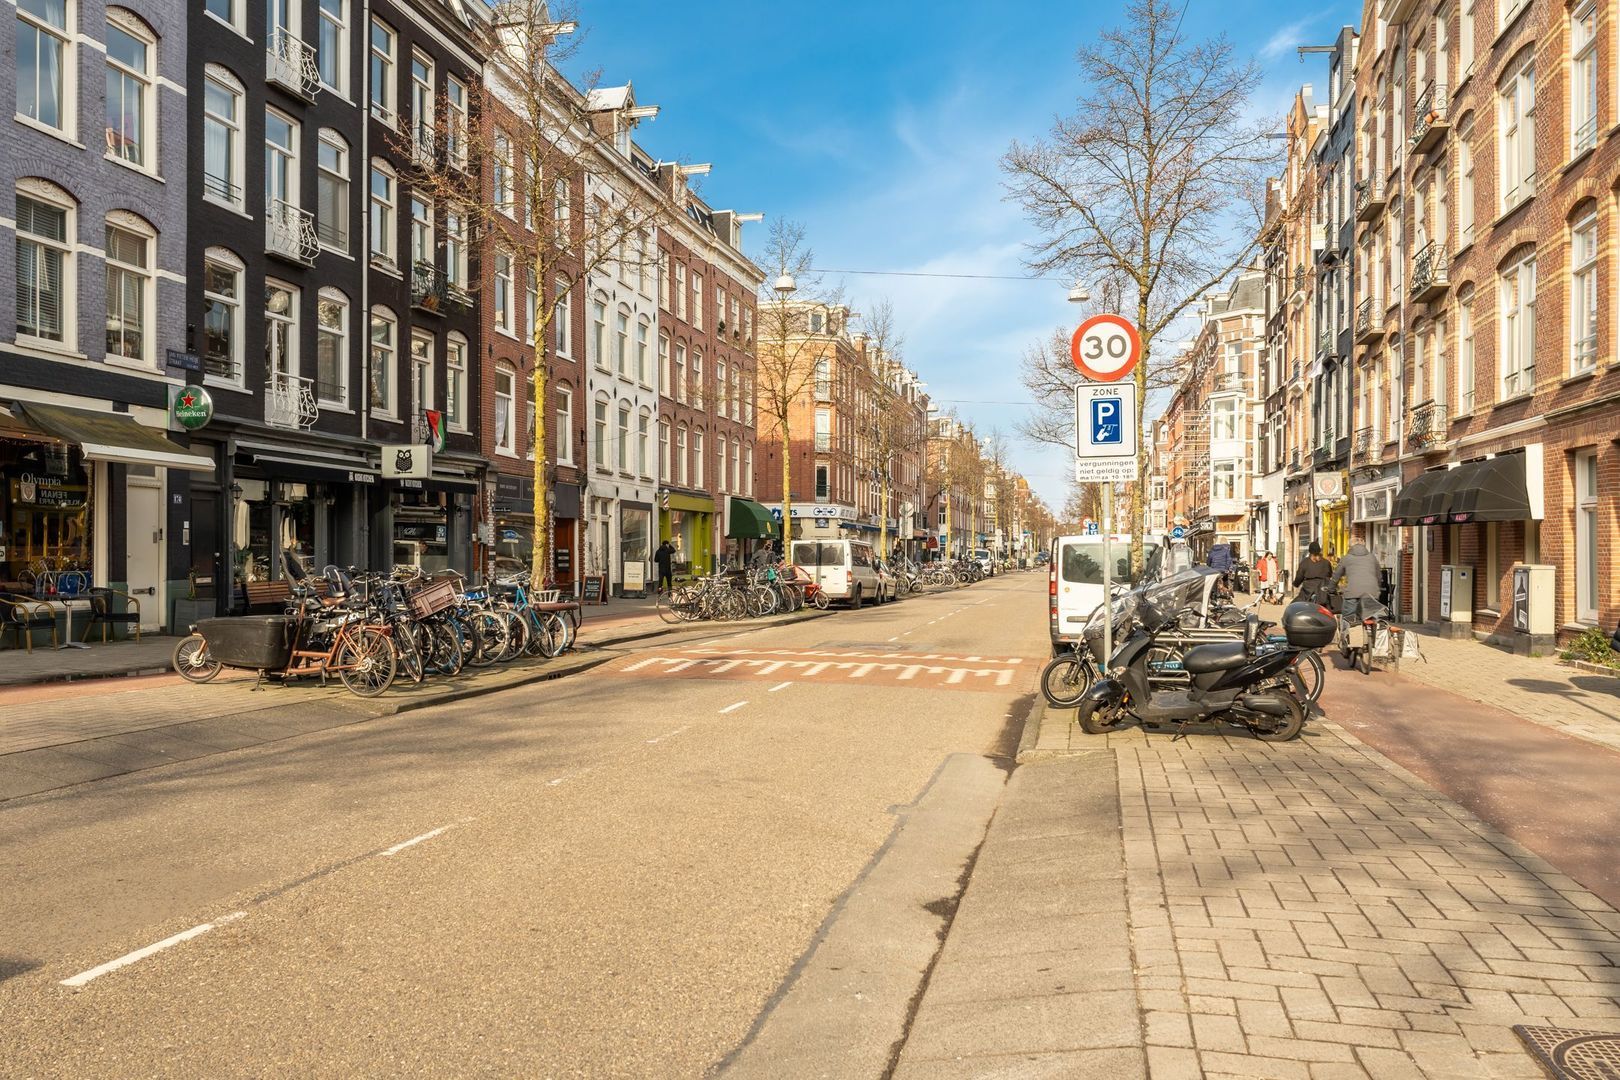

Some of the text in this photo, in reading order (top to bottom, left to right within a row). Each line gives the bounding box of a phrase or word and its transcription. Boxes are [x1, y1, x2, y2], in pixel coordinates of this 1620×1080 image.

[1084, 335, 1127, 360] 30
[1093, 388, 1119, 396] ZONE
[1097, 403, 1114, 424] P
[1080, 460, 1134, 468] vergunningen
[21, 472, 61, 487] Olympia
